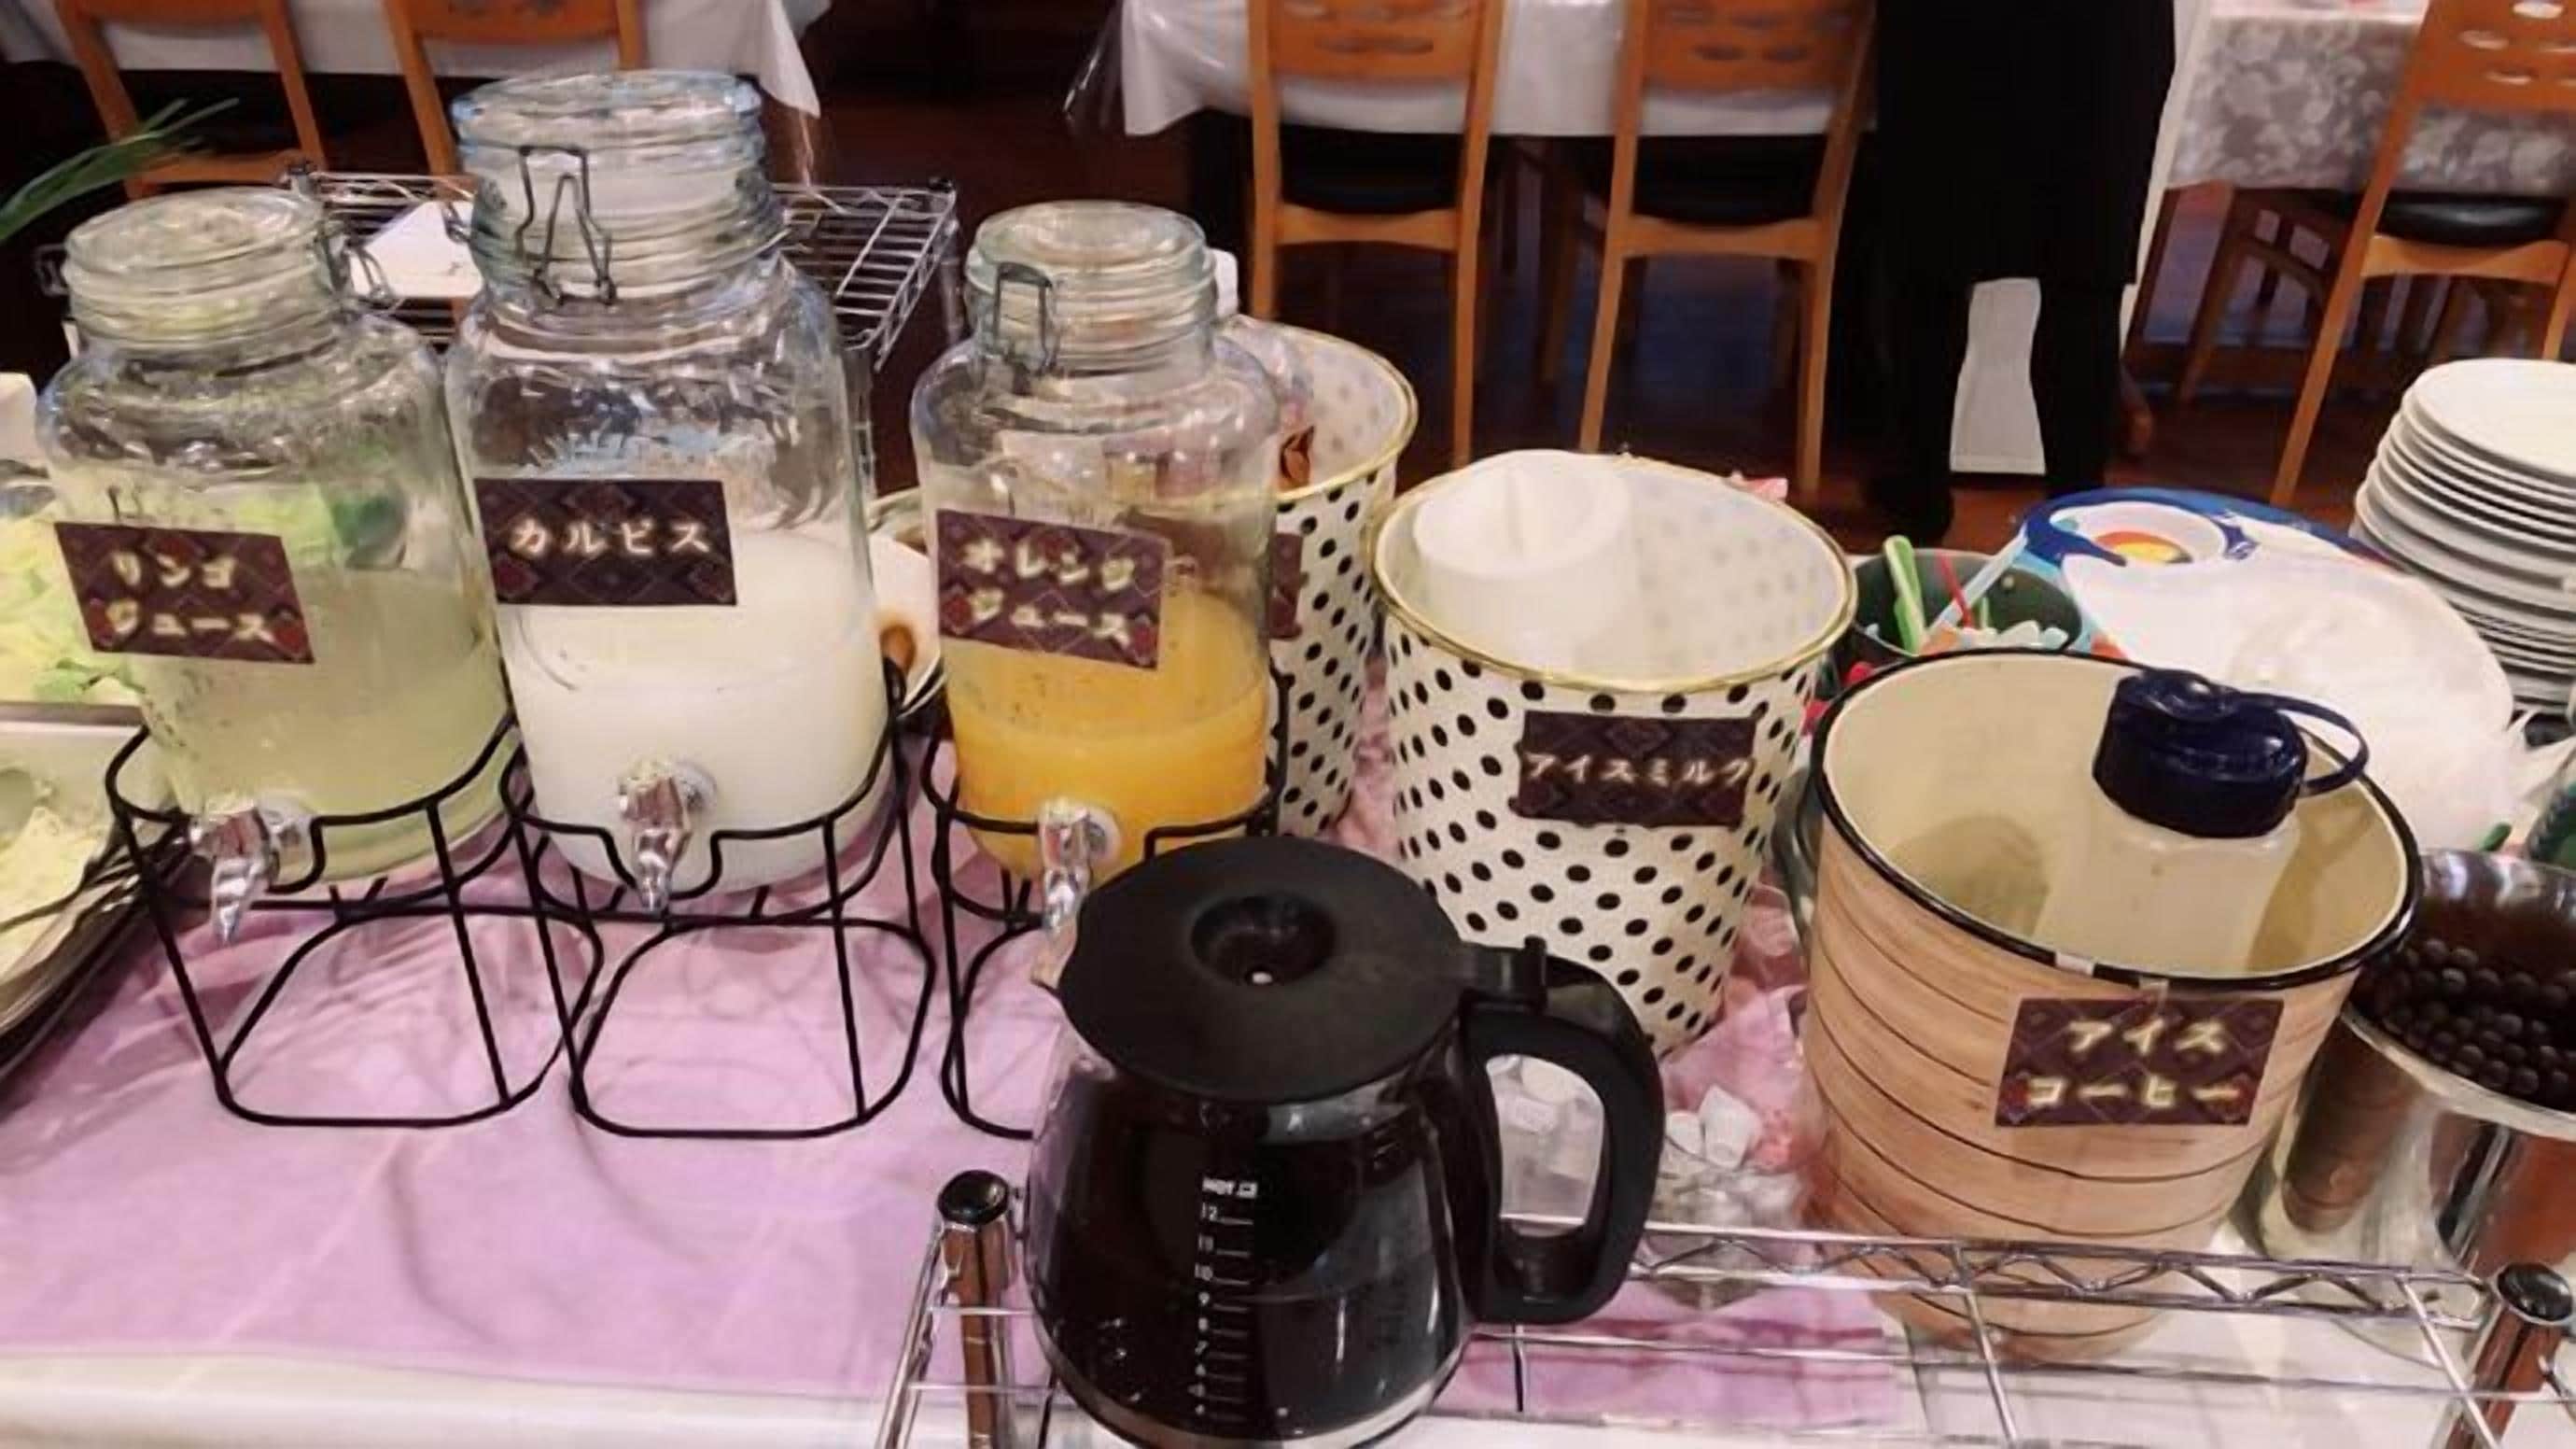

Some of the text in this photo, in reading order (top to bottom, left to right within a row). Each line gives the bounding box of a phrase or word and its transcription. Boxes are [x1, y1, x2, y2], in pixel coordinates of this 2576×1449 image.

[510, 515, 711, 557] カルピス
[108, 550, 236, 590] リンゴ
[960, 537, 1137, 593] オレンジ
[105, 598, 277, 644] ジュース
[966, 586, 1131, 650] ジュース
[1524, 751, 1756, 787] アイスミルク
[2065, 1017, 2226, 1055] アイス
[2028, 1076, 2242, 1108] コーヒー
